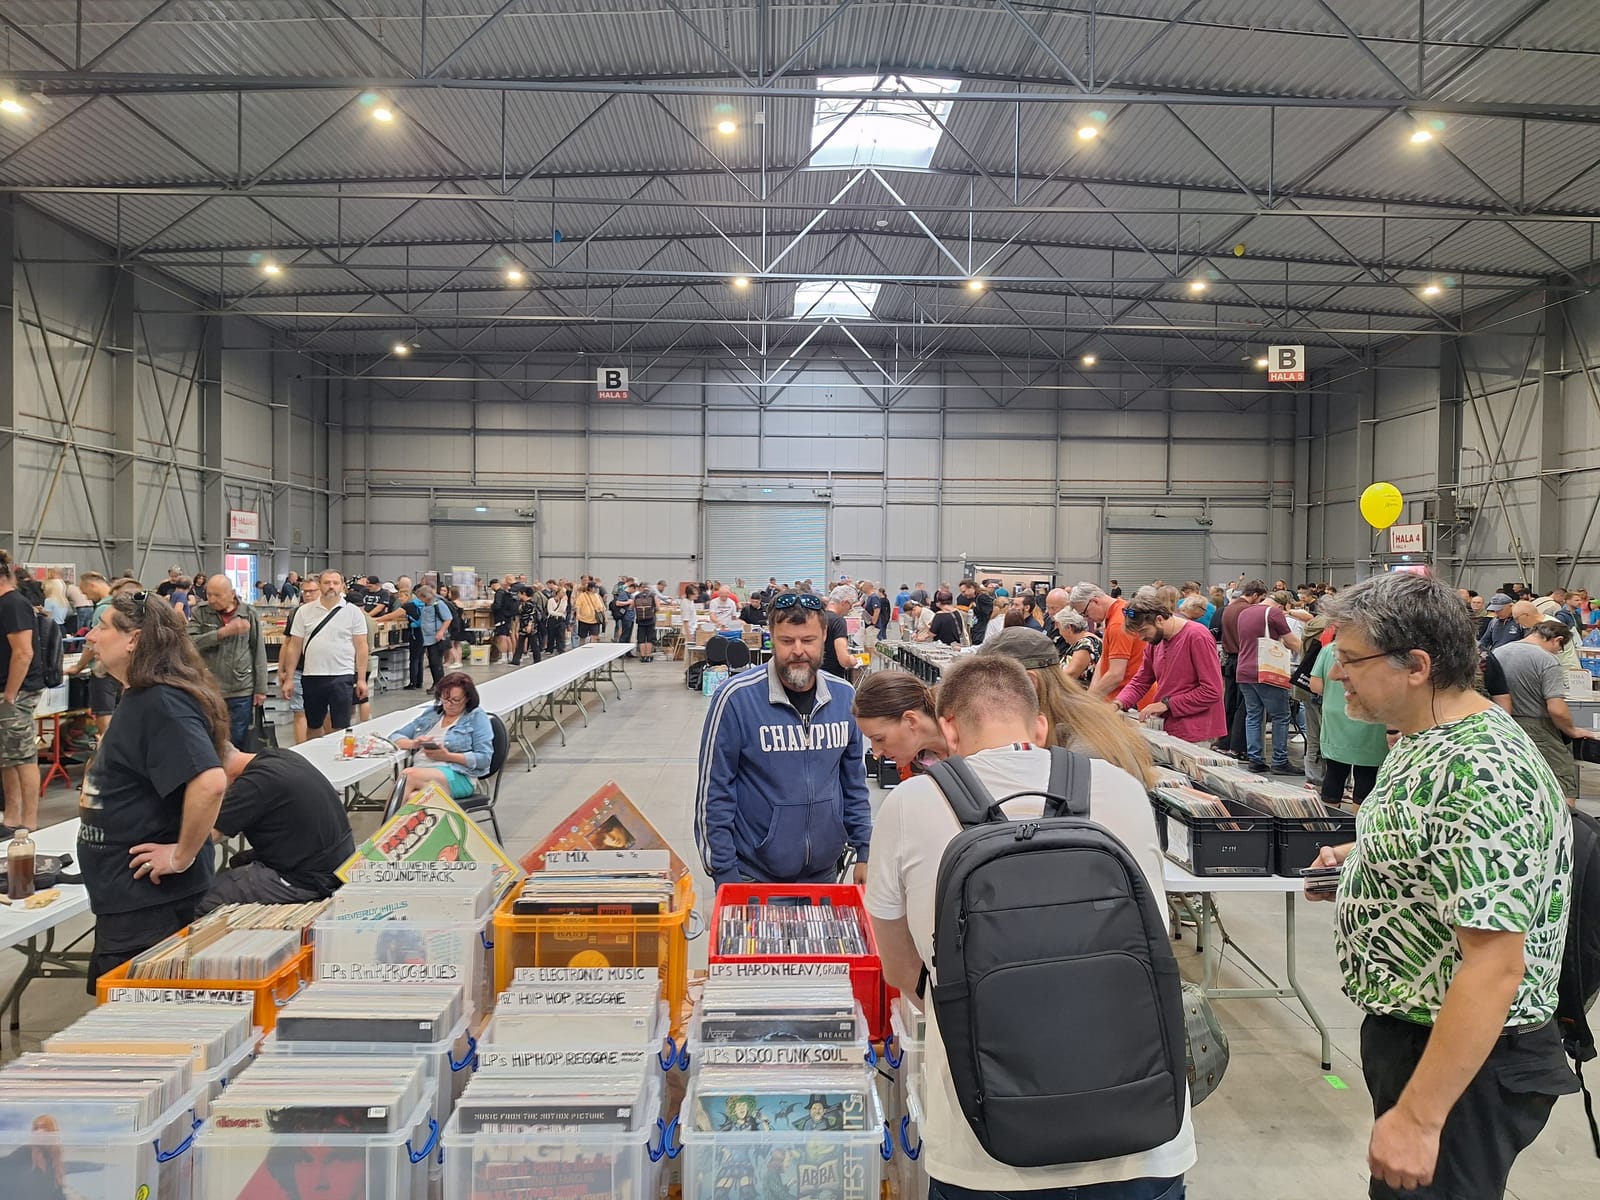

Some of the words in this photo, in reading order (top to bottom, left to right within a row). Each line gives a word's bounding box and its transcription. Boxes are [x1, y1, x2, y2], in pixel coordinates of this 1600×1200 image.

[1279, 348, 1296, 369] B
[605, 370, 621, 389] B
[1395, 534, 1414, 543] HALA
[1415, 534, 1420, 542] 4
[759, 721, 849, 752] CHAMPION
[566, 852, 590, 863] MIX
[375, 870, 455, 882] SOUNDTRACK
[540, 968, 604, 982] ELECTRONIC
[608, 968, 645, 980] MUSIC
[134, 989, 173, 1003] INDIE
[175, 990, 205, 1001] NEW
[540, 1112, 569, 1120] MOTION
[801, 1164, 837, 1186] ABBA
